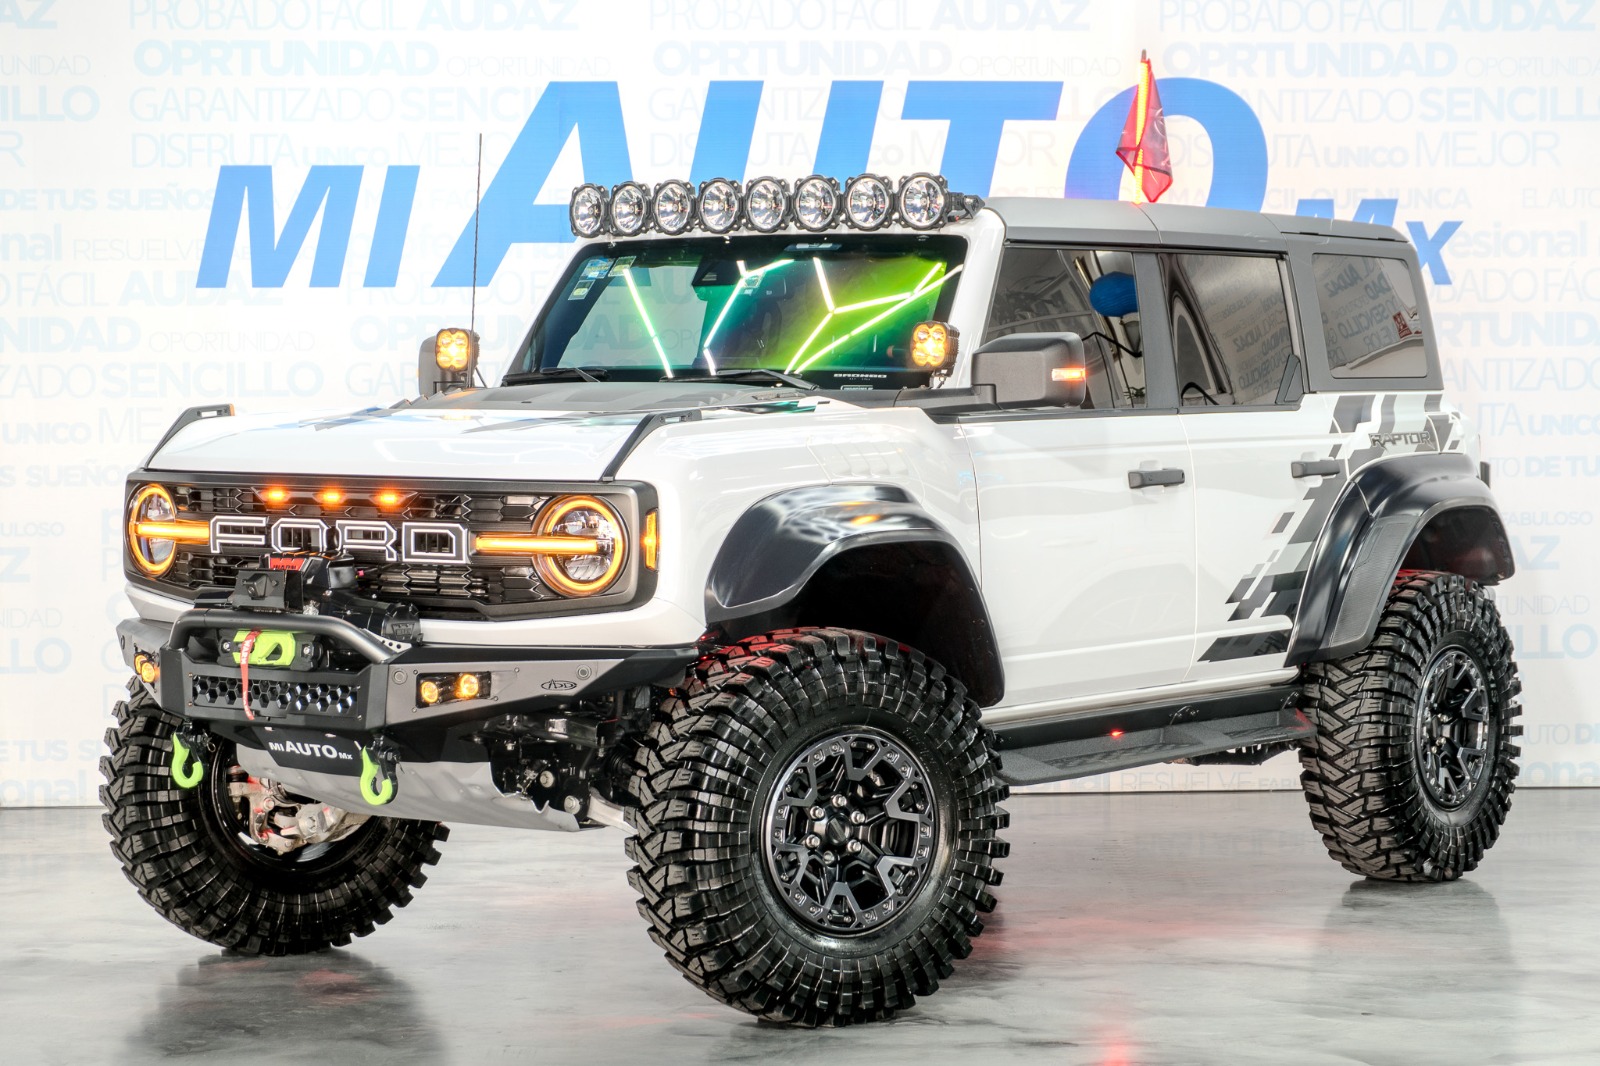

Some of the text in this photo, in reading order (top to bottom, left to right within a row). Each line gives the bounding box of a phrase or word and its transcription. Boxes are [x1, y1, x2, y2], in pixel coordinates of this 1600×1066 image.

[130, 0, 312, 31] PROBADO
[416, 0, 580, 31] AUDAZ
[650, 0, 827, 31] PROBADO
[929, 0, 1091, 31] AUDAZ
[1159, 0, 1334, 32] PROBADO
[1436, 0, 1597, 32] AUDAZ
[134, 39, 612, 77] OPRTUNIDAD OPORTUNIDAD
[652, 40, 1122, 77] OPRTUNIDAD OPORTUNIDAD
[1161, 41, 1458, 77] OPRTUNIDAD
[129, 86, 394, 123] GARANTIZADO
[132, 133, 298, 168] DISFRUTA
[1324, 146, 1410, 168] UNICO
[1416, 130, 1562, 168] MEJOR
[196, 165, 420, 288] MI
[148, 330, 316, 353] OPORTUNIDAD
[102, 361, 325, 398] SENCILLO
[3, 422, 92, 444] UNICO
[1368, 431, 1436, 451] RAPTOR
[1525, 455, 1561, 478] DE
[210, 515, 471, 565] FORD
[285, 740, 338, 759] AUTO
